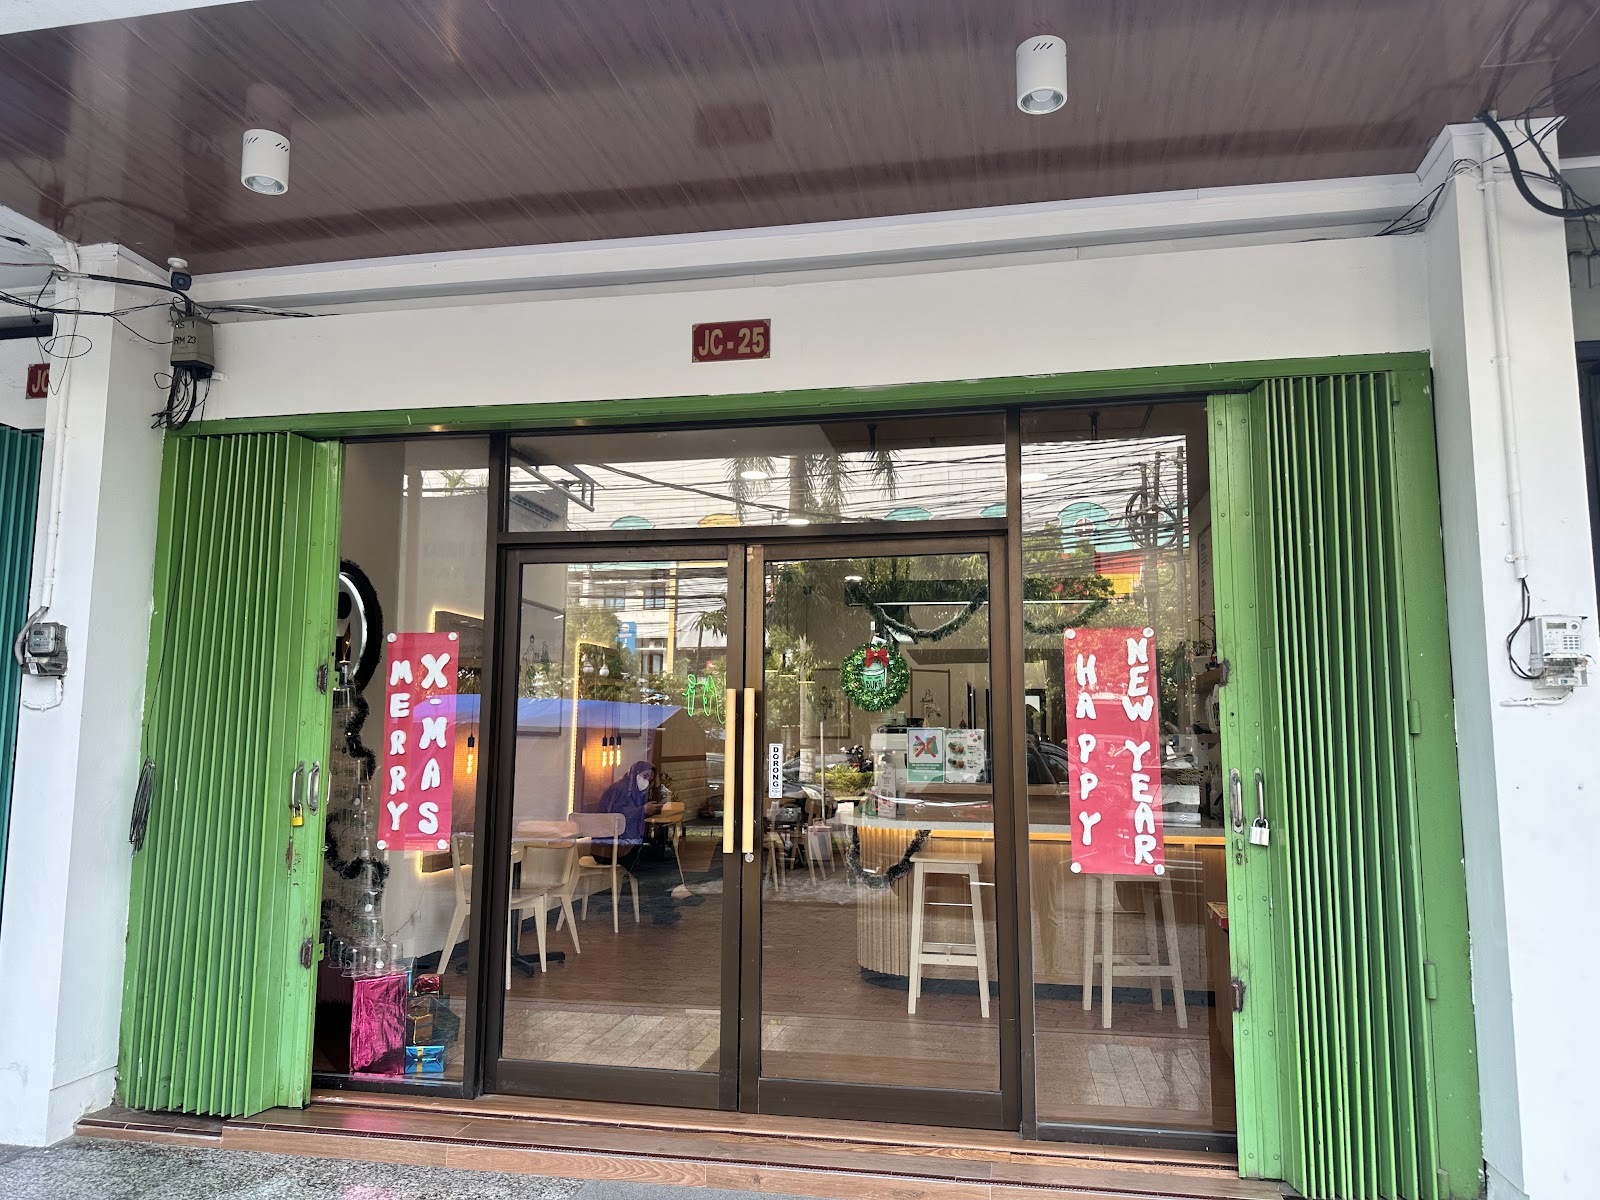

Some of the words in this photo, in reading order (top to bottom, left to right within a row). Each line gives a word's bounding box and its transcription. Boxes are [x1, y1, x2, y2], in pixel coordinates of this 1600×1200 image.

[174, 336, 185, 345] RM
[187, 334, 197, 344] 23
[386, 659, 414, 832] MERRY
[418, 652, 451, 835] X-MAS
[1075, 653, 1102, 846] HAPPY
[1122, 637, 1154, 722] NEW
[1125, 739, 1157, 866] YEAR
